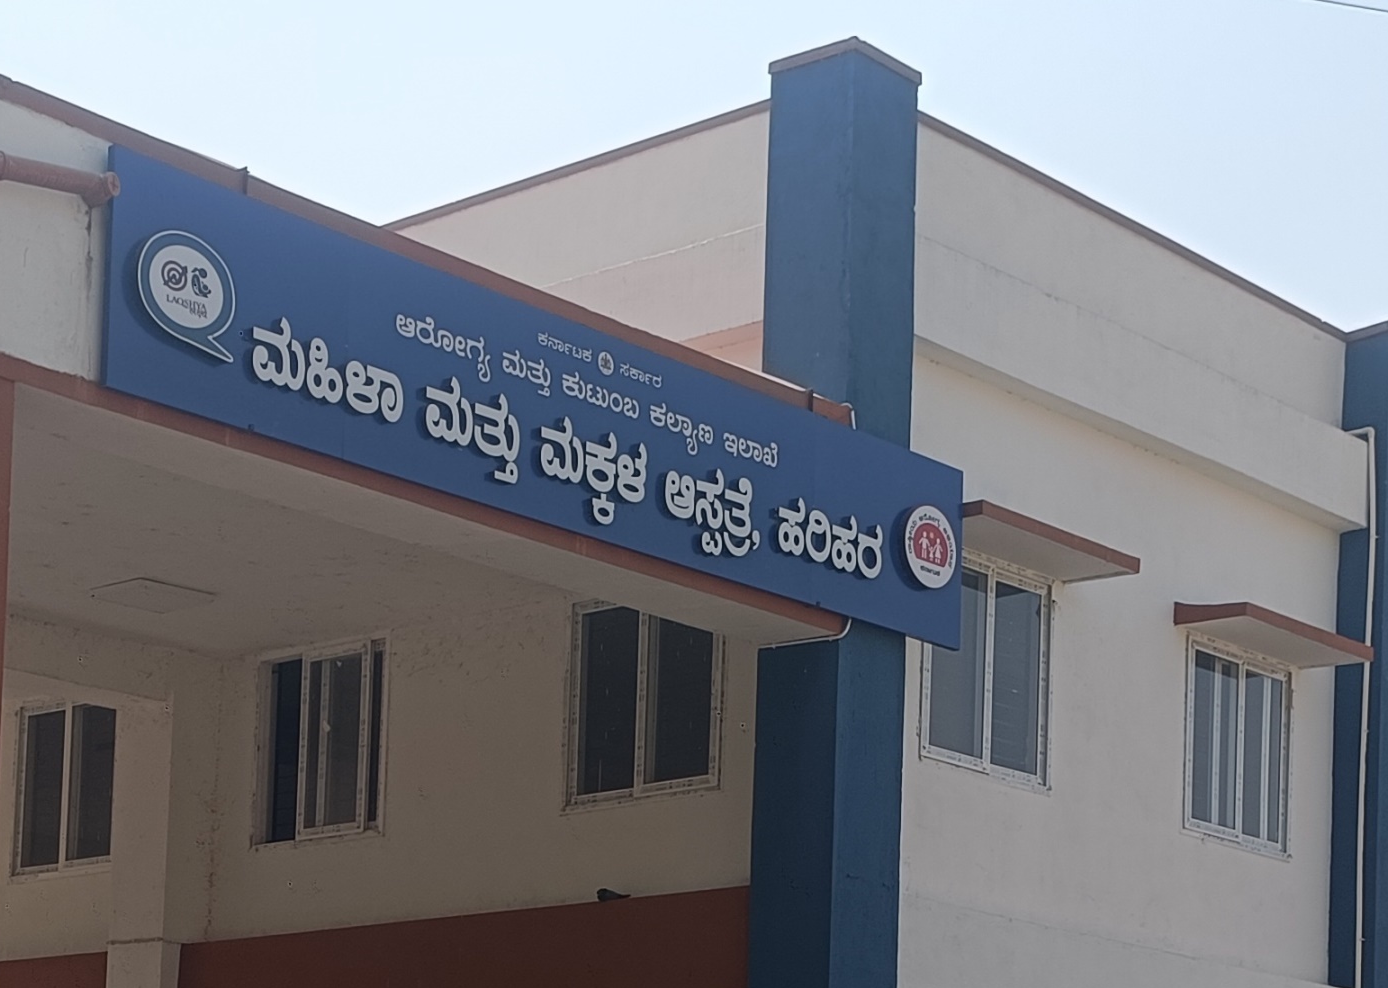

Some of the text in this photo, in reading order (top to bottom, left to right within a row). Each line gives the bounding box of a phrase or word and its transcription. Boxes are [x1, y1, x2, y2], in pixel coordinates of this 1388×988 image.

[396, 313, 779, 468] ಆರೋಗ್ಯ ಮತ್ತು ಕುಟುಂಬ ಕಲ್ಯಾಣ ಇಲಾಖೆ
[537, 332, 662, 388] ಕರ್ನಾಟಕ ಸರ್ಕಾರ
[252, 317, 883, 579] ಮಹಿಳಾ ಮತ್ತು ಮಕ್ಕಳ ಆಸ್ಪತ್ರೆ, ಹರಿಹರ
